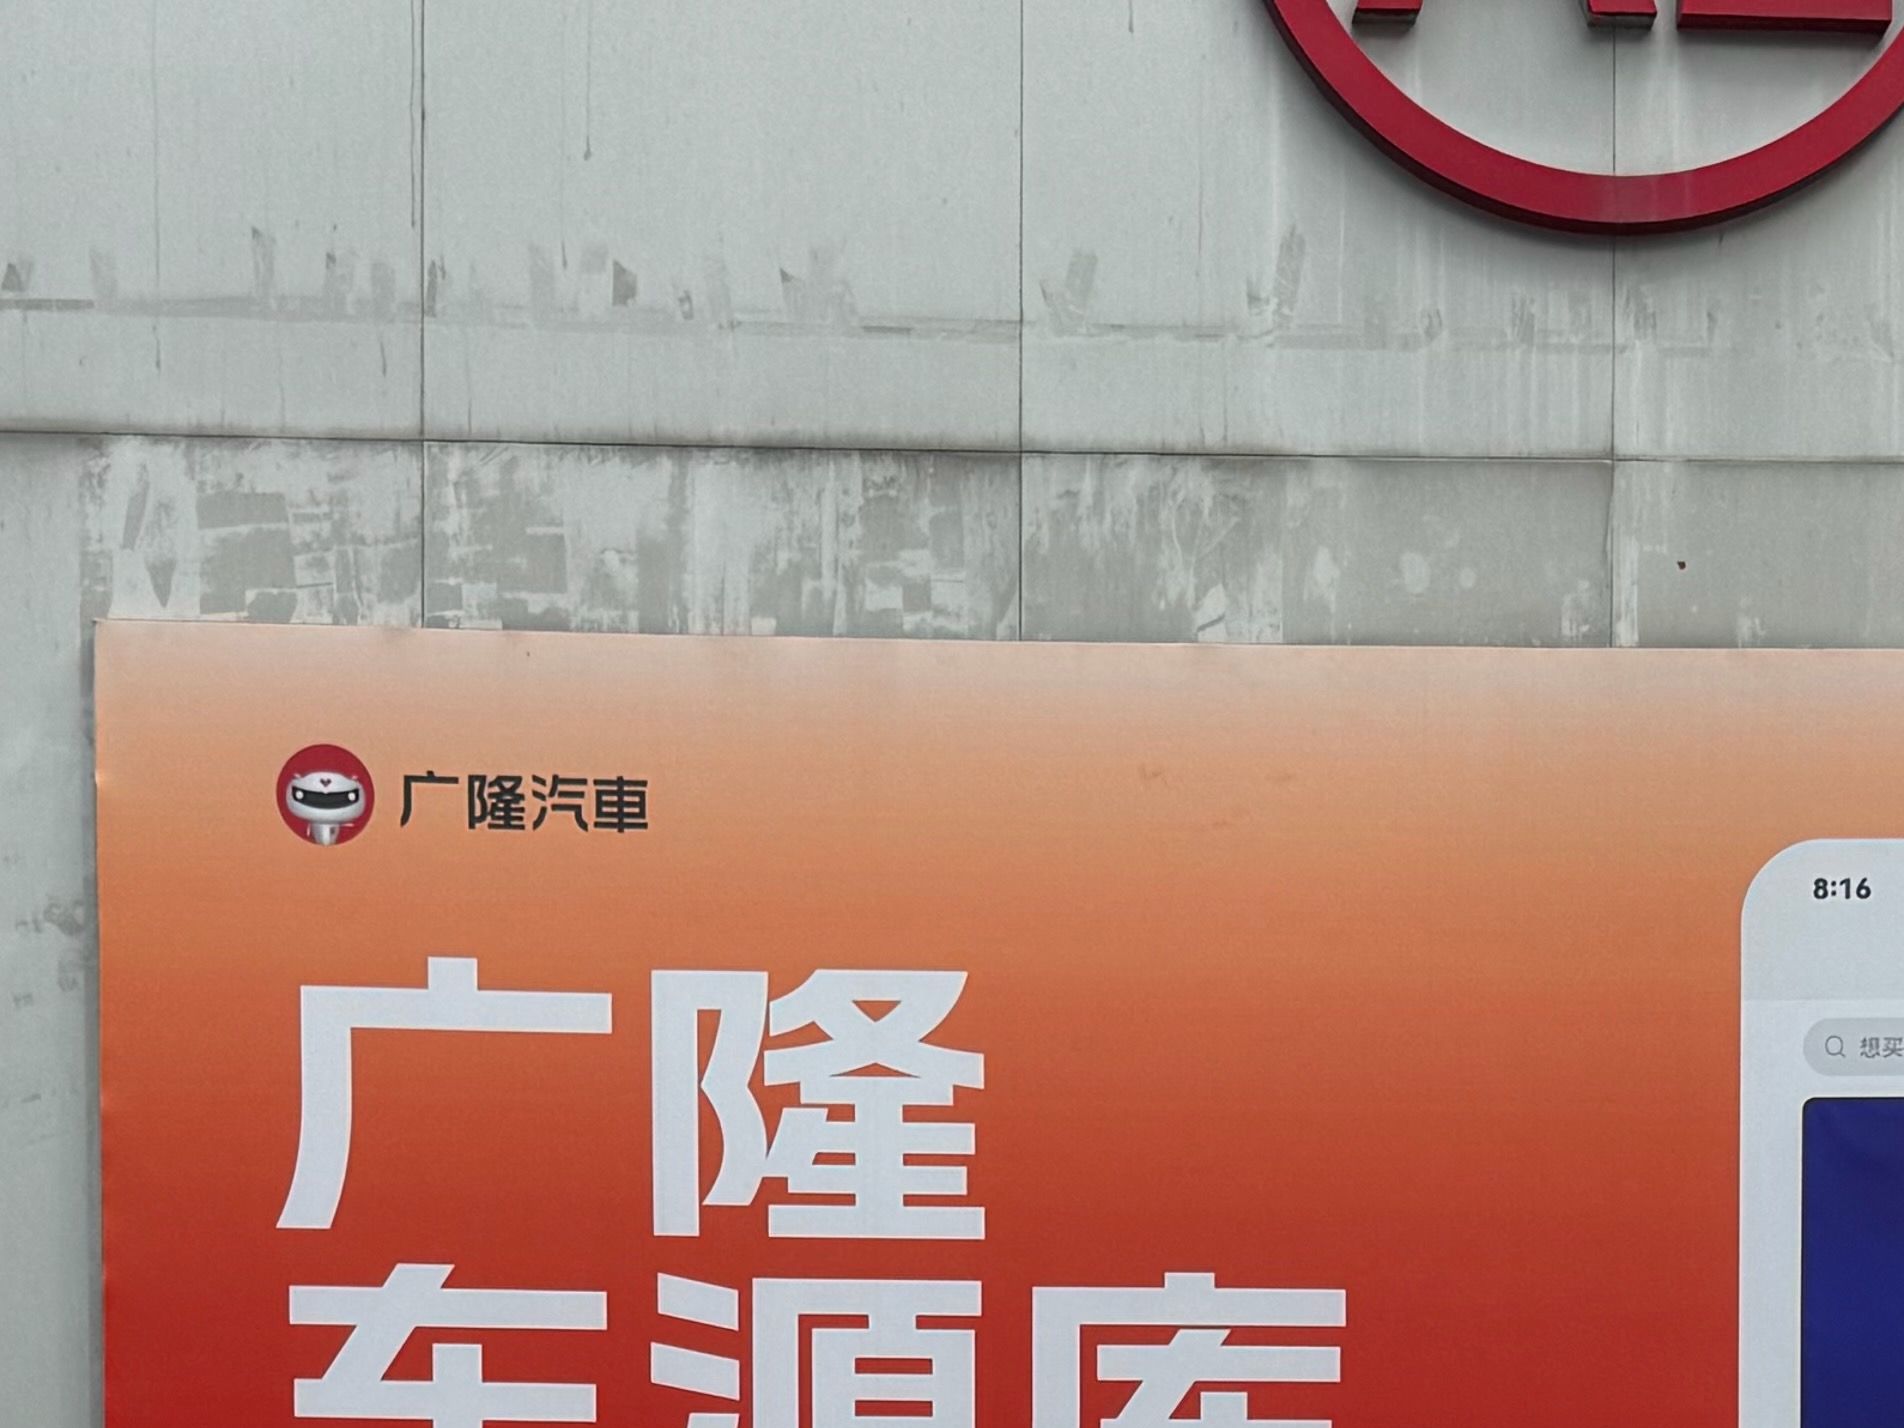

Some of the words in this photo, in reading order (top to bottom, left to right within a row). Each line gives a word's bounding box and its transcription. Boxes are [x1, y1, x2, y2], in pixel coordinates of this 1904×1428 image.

[400, 771, 648, 833] 广隆汽車
[1814, 878, 1871, 899] 8:16
[276, 956, 985, 1239] 广隆
